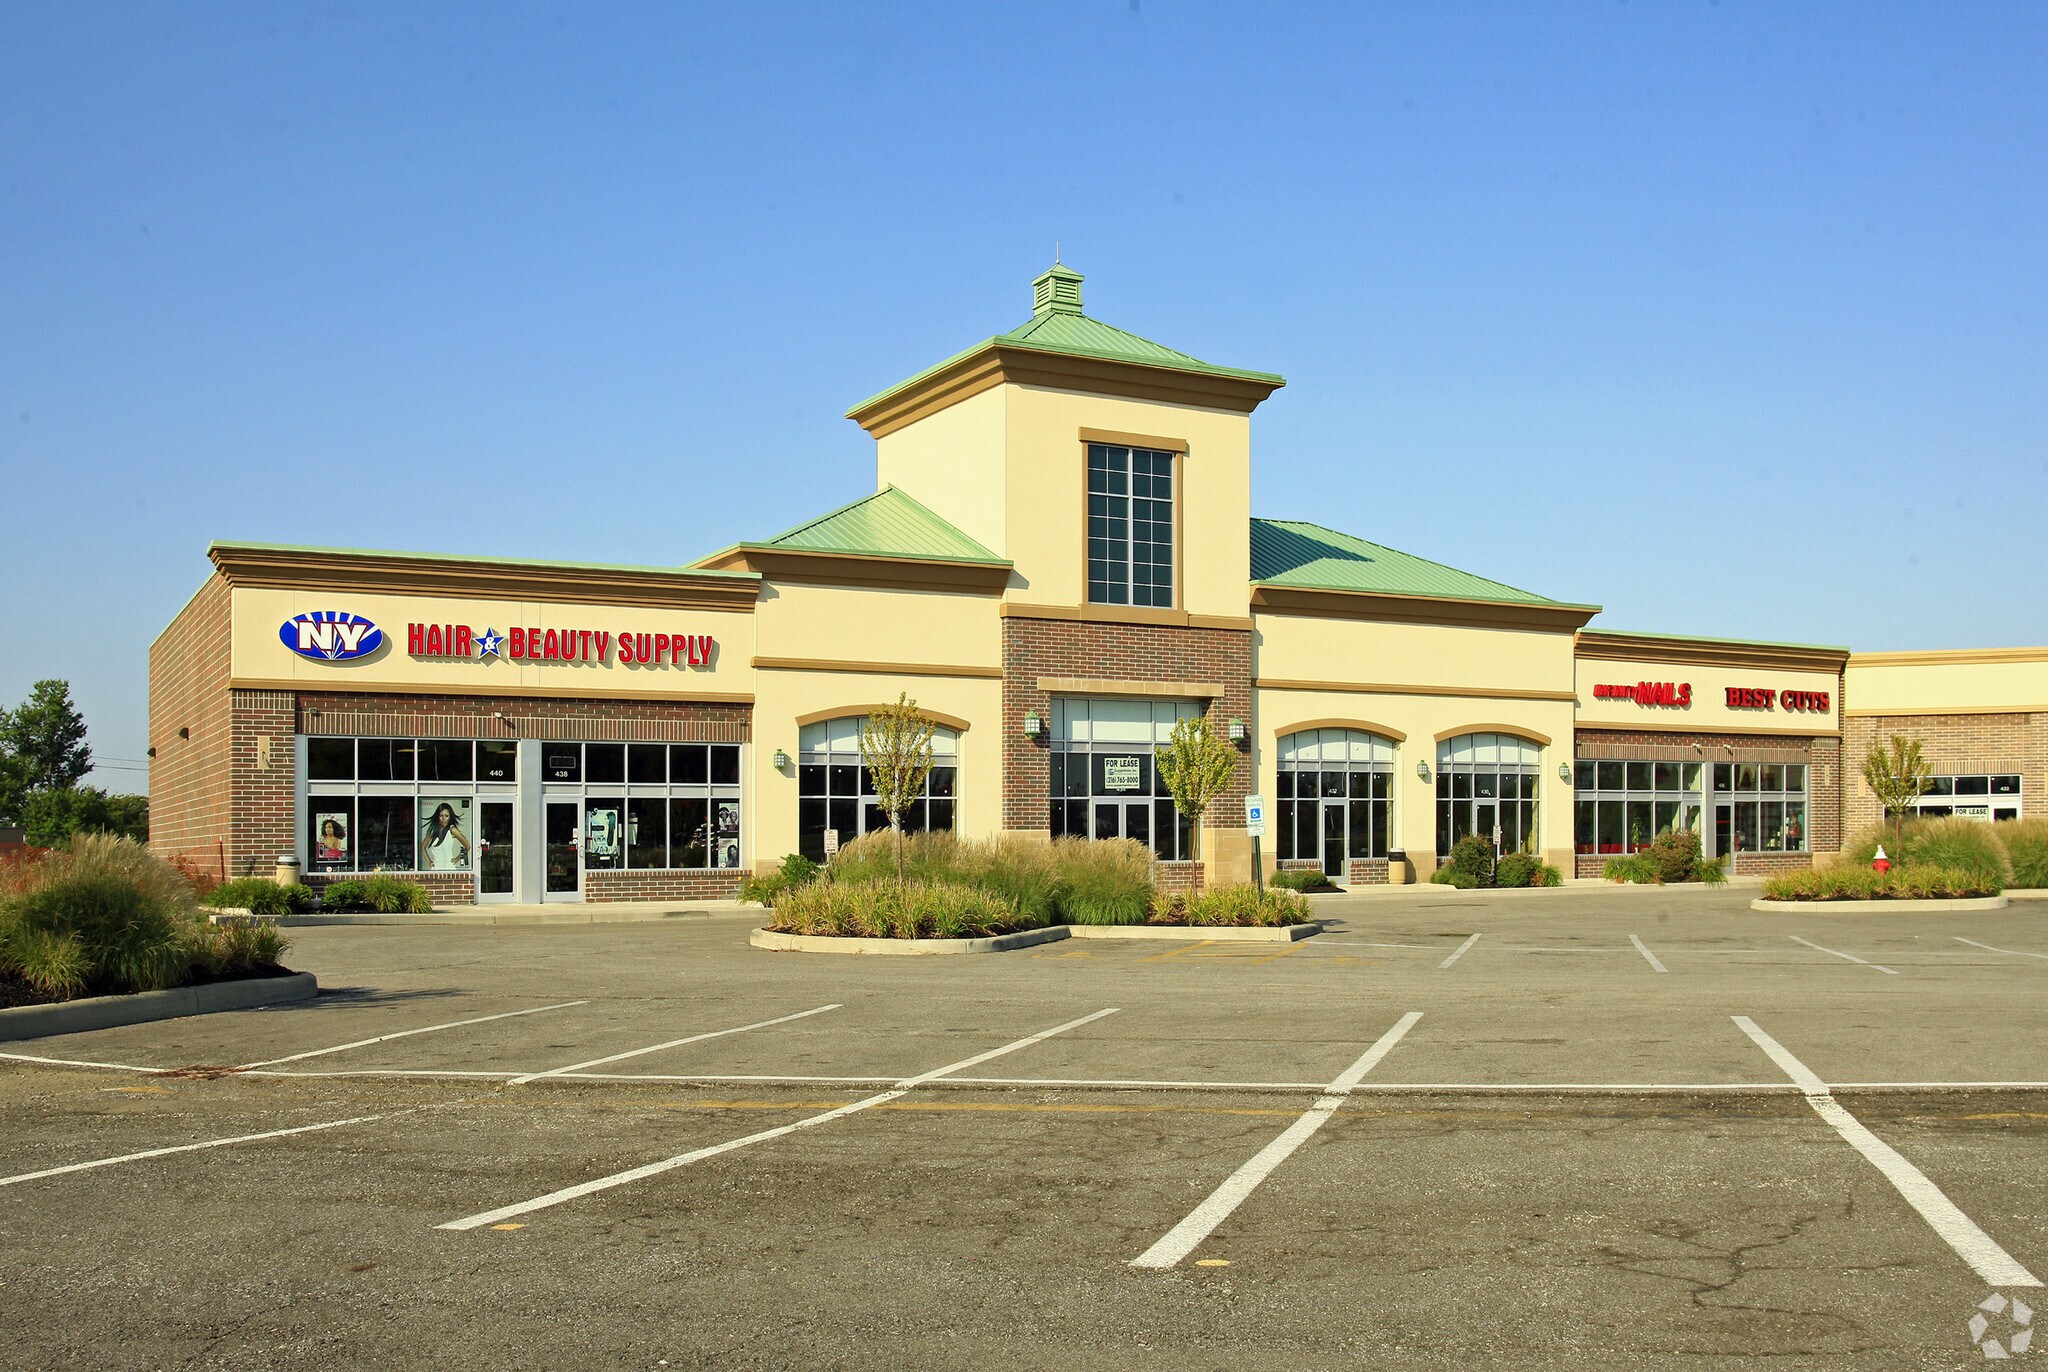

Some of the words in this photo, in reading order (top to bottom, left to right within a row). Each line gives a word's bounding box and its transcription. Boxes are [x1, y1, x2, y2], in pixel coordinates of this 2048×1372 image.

[297, 620, 369, 652] NY
[407, 623, 472, 657] HAIR
[483, 636, 497, 651] &
[509, 627, 609, 662] BEAUTY
[618, 632, 713, 666] SUPPLY
[1636, 681, 1692, 706] NAILS
[1725, 687, 1776, 708] BEST
[1780, 690, 1830, 711] CUTS
[489, 769, 504, 777] 440
[554, 770, 569, 778] 438
